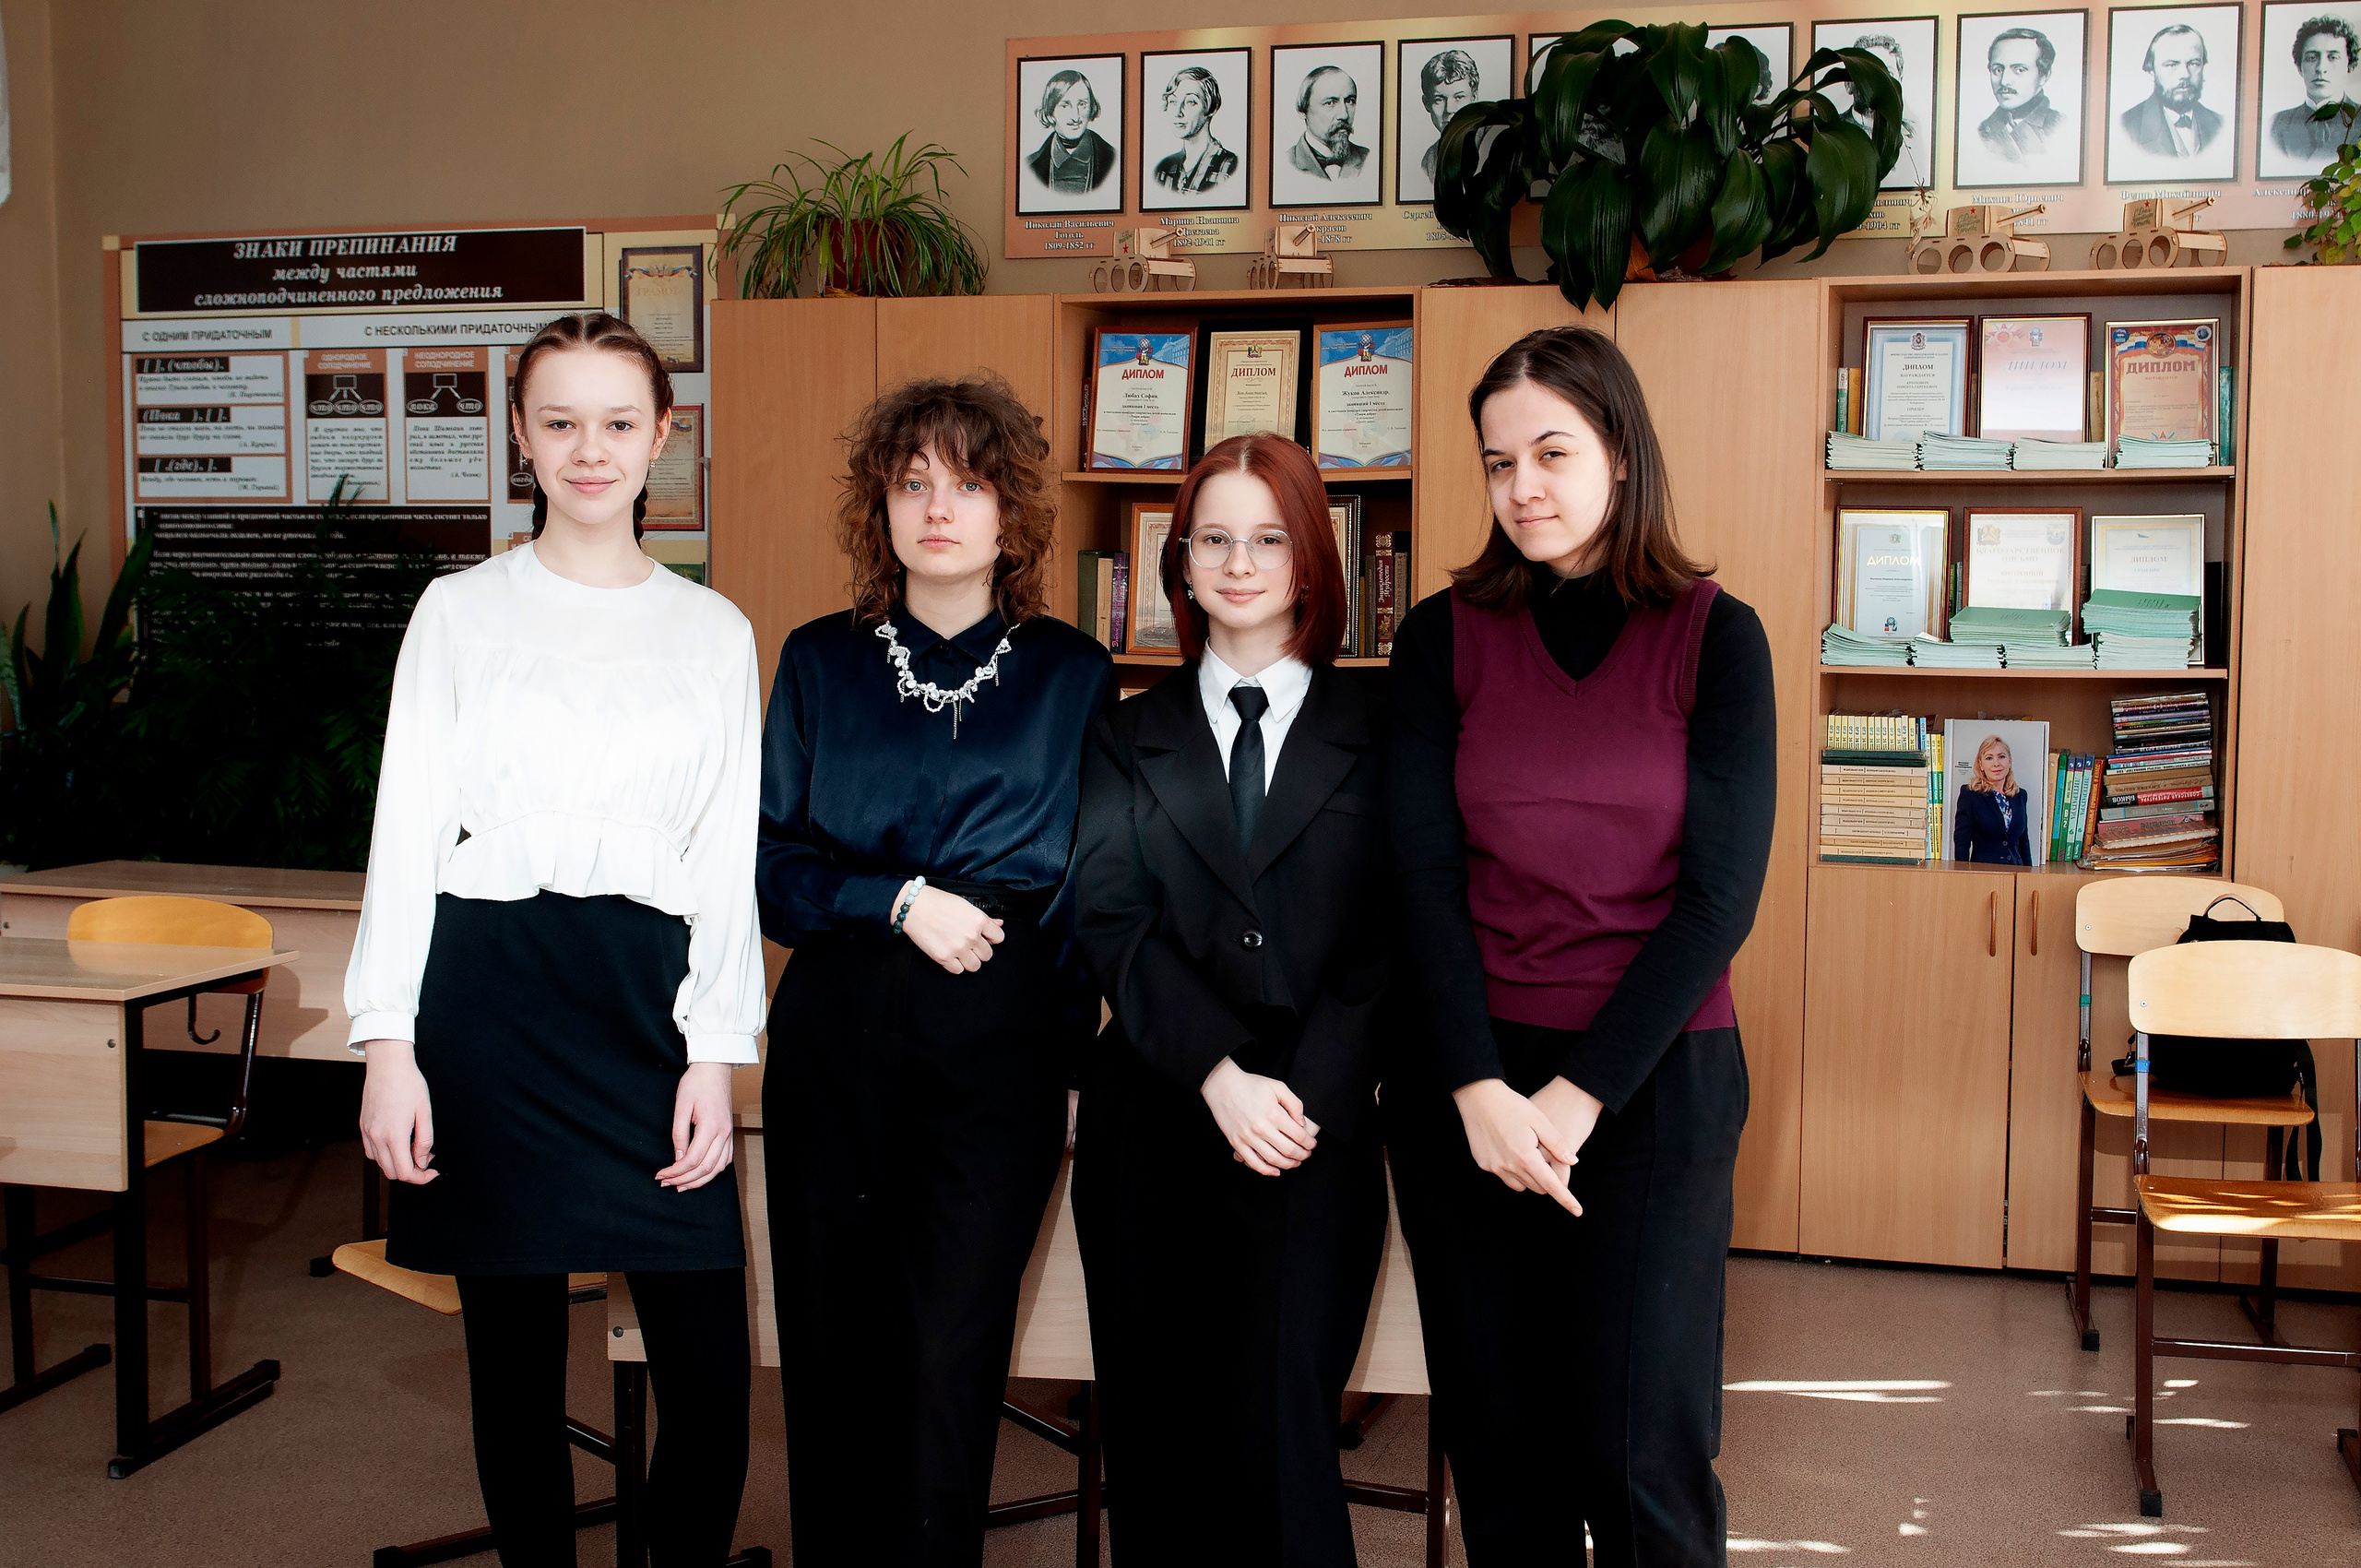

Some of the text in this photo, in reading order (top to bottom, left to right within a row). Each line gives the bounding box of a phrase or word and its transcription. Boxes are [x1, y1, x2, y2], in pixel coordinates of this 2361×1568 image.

[2154, 188, 2222, 199] Михайлович
[2252, 187, 2309, 197] Александр
[1874, 198, 1913, 207] влович
[1972, 194, 2064, 205] Михаил Юрьевич
[1279, 212, 1372, 222] Николай Алексеевич
[1402, 210, 1434, 220] Сергей
[1025, 220, 1115, 230] Николай Васильевич
[1159, 216, 1240, 227] Марина Ивановна
[1306, 225, 1347, 234] красов
[1055, 231, 1084, 240] Гоголь
[1318, 234, 1341, 244] -1878
[1427, 232, 1456, 241] 1895-1
[1044, 242, 1084, 250] 1809-1852
[1173, 237, 1214, 247] 1892-1941
[233, 235, 458, 260] ЗНАКИ ПРЕПИНАНИЯ
[272, 263, 419, 285] между частями
[194, 282, 504, 306] сложноподчиненного предложения
[636, 287, 684, 297] ГРАМОТА
[364, 322, 549, 337] С НЕСКОЛЬКИМИ ПРИДАТОЧНЫ
[142, 329, 273, 343] С ОДНИМ ПРИДАТОЧНЫМ
[322, 353, 368, 362] ОДНОРОДНОЕ
[414, 350, 475, 360] НЕОДНОРОДНОЕ
[317, 361, 372, 370] СОПОДЧИНЕНИЕ
[414, 360, 475, 369] СОПОДЧИНЕНИЕ
[2126, 360, 2196, 375] ДИПЛОМ
[1121, 369, 1165, 380] ДИПЛОМ
[1230, 367, 1276, 378] ДИПЛОМ
[1344, 364, 1388, 378] ДИПЛОМ
[1840, 374, 1845, 382] 5
[1866, 555, 1921, 566] ДИПЛОМ
[1377, 559, 1385, 603] Энциклопедия
[1383, 564, 1392, 598] Мудрости
[2070, 777, 2081, 820] ЛИТЕРАТУРА
[2079, 776, 2090, 816] ЛИТЕРАТУРА
[2111, 794, 2135, 803] БЫКОВ
[2140, 790, 2201, 802] СОВЕТСКАЯ ЛИТЕРАТУРА
[2062, 820, 2068, 828] 2
